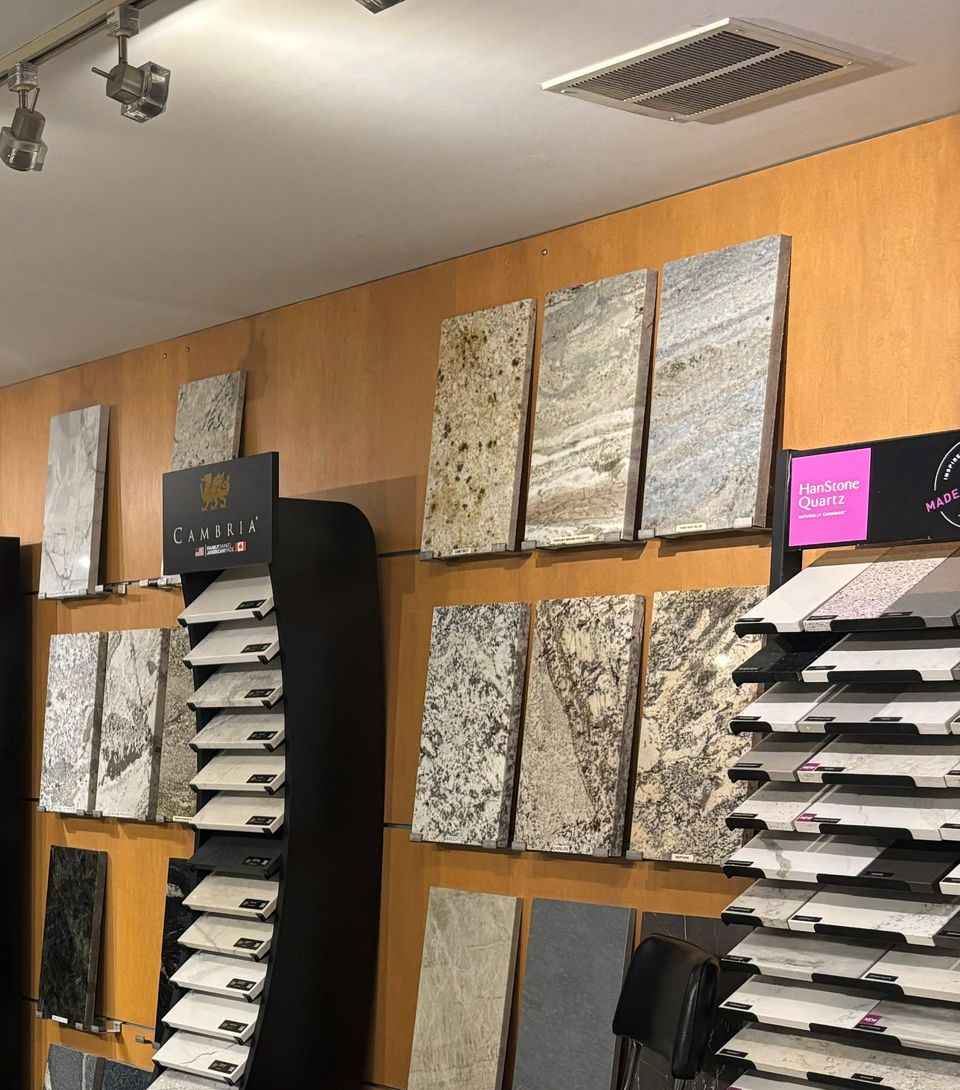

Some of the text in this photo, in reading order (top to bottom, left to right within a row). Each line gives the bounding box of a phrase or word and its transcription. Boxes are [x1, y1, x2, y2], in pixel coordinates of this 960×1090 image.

[799, 480, 860, 495] HanStone
[798, 495, 845, 510] Quartz
[926, 488, 960, 512] MADE
